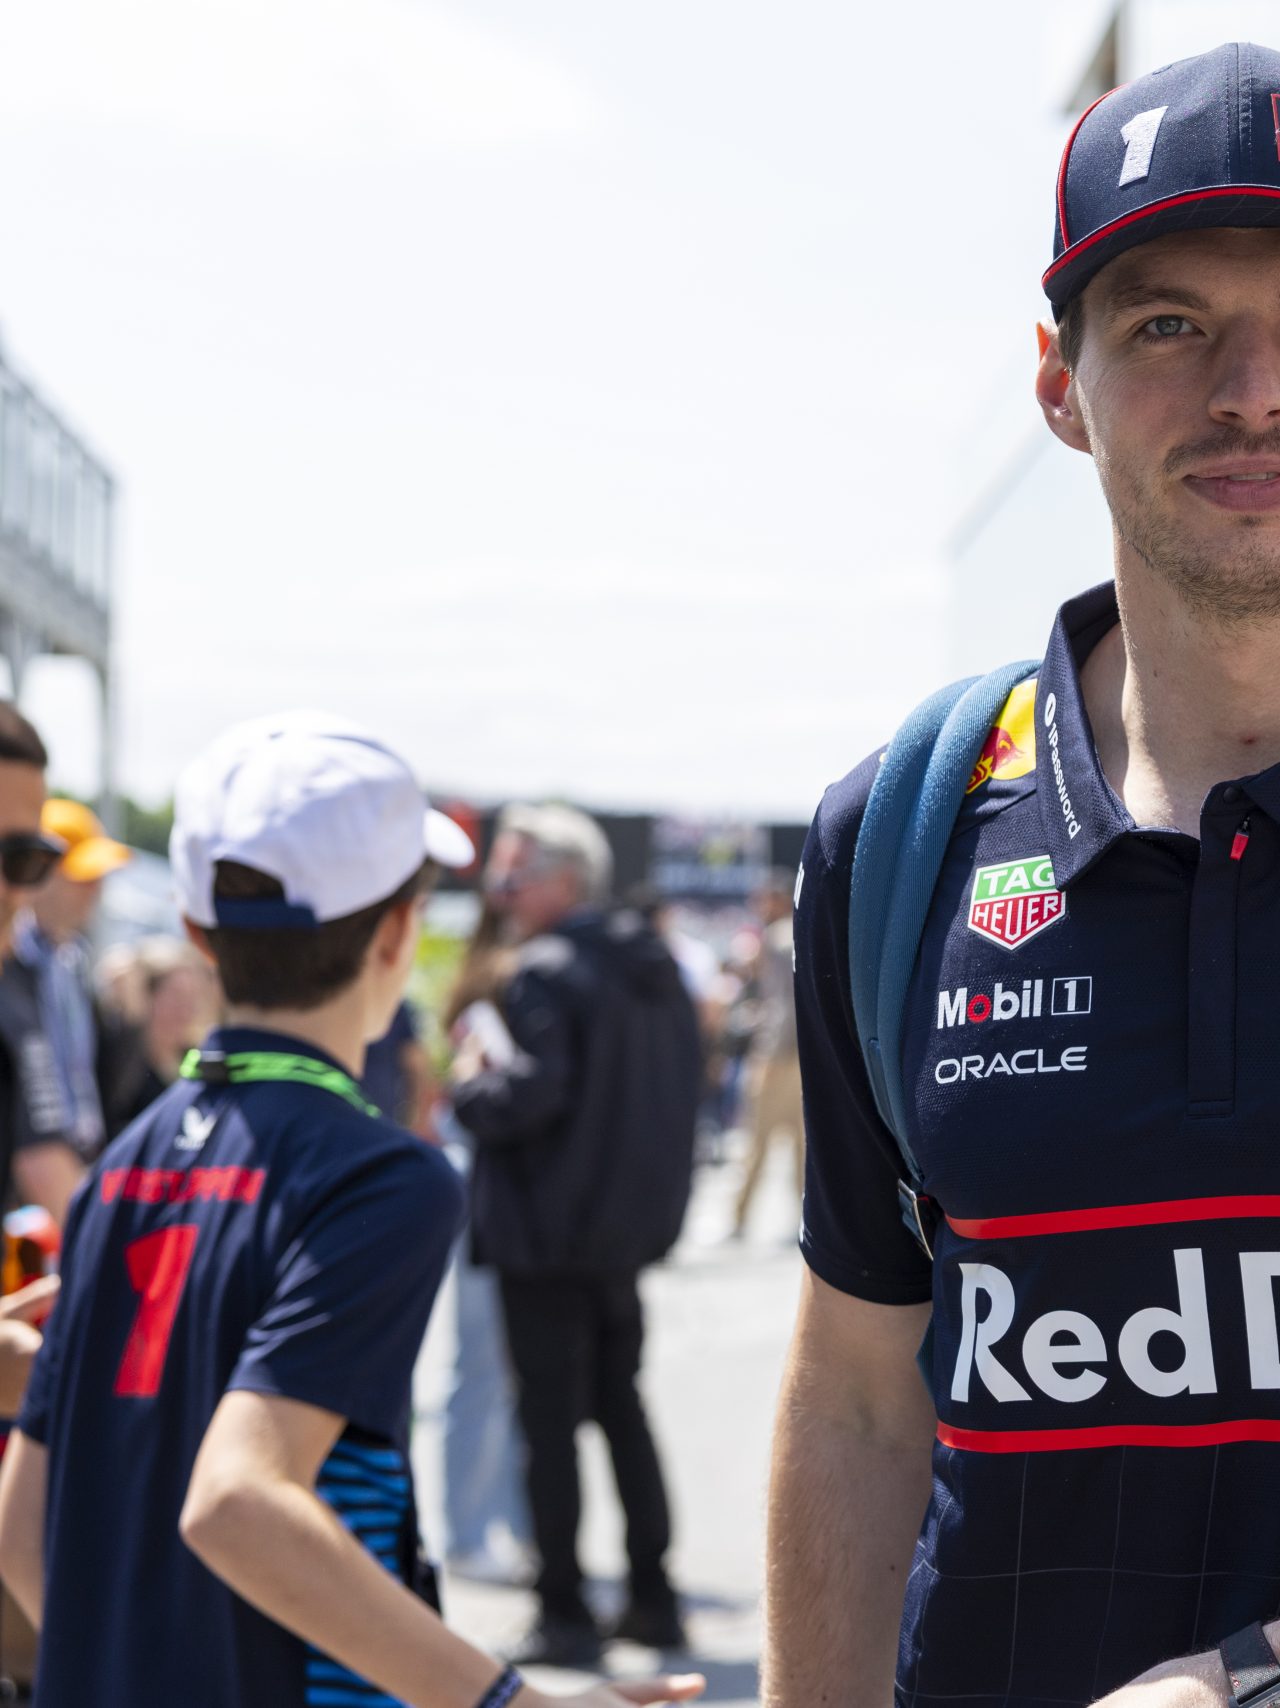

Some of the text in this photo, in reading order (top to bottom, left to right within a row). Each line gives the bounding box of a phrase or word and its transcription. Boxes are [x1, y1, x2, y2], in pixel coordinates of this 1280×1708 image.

[1118, 106, 1169, 187] 1
[1048, 722, 1081, 840] 1Password
[982, 861, 1056, 896] TAG
[974, 895, 1059, 942] HEUER
[937, 978, 1043, 1029] Mobil
[935, 1046, 1088, 1084] ORACLE
[113, 1224, 199, 1398] 1
[950, 1246, 1219, 1403] Red
